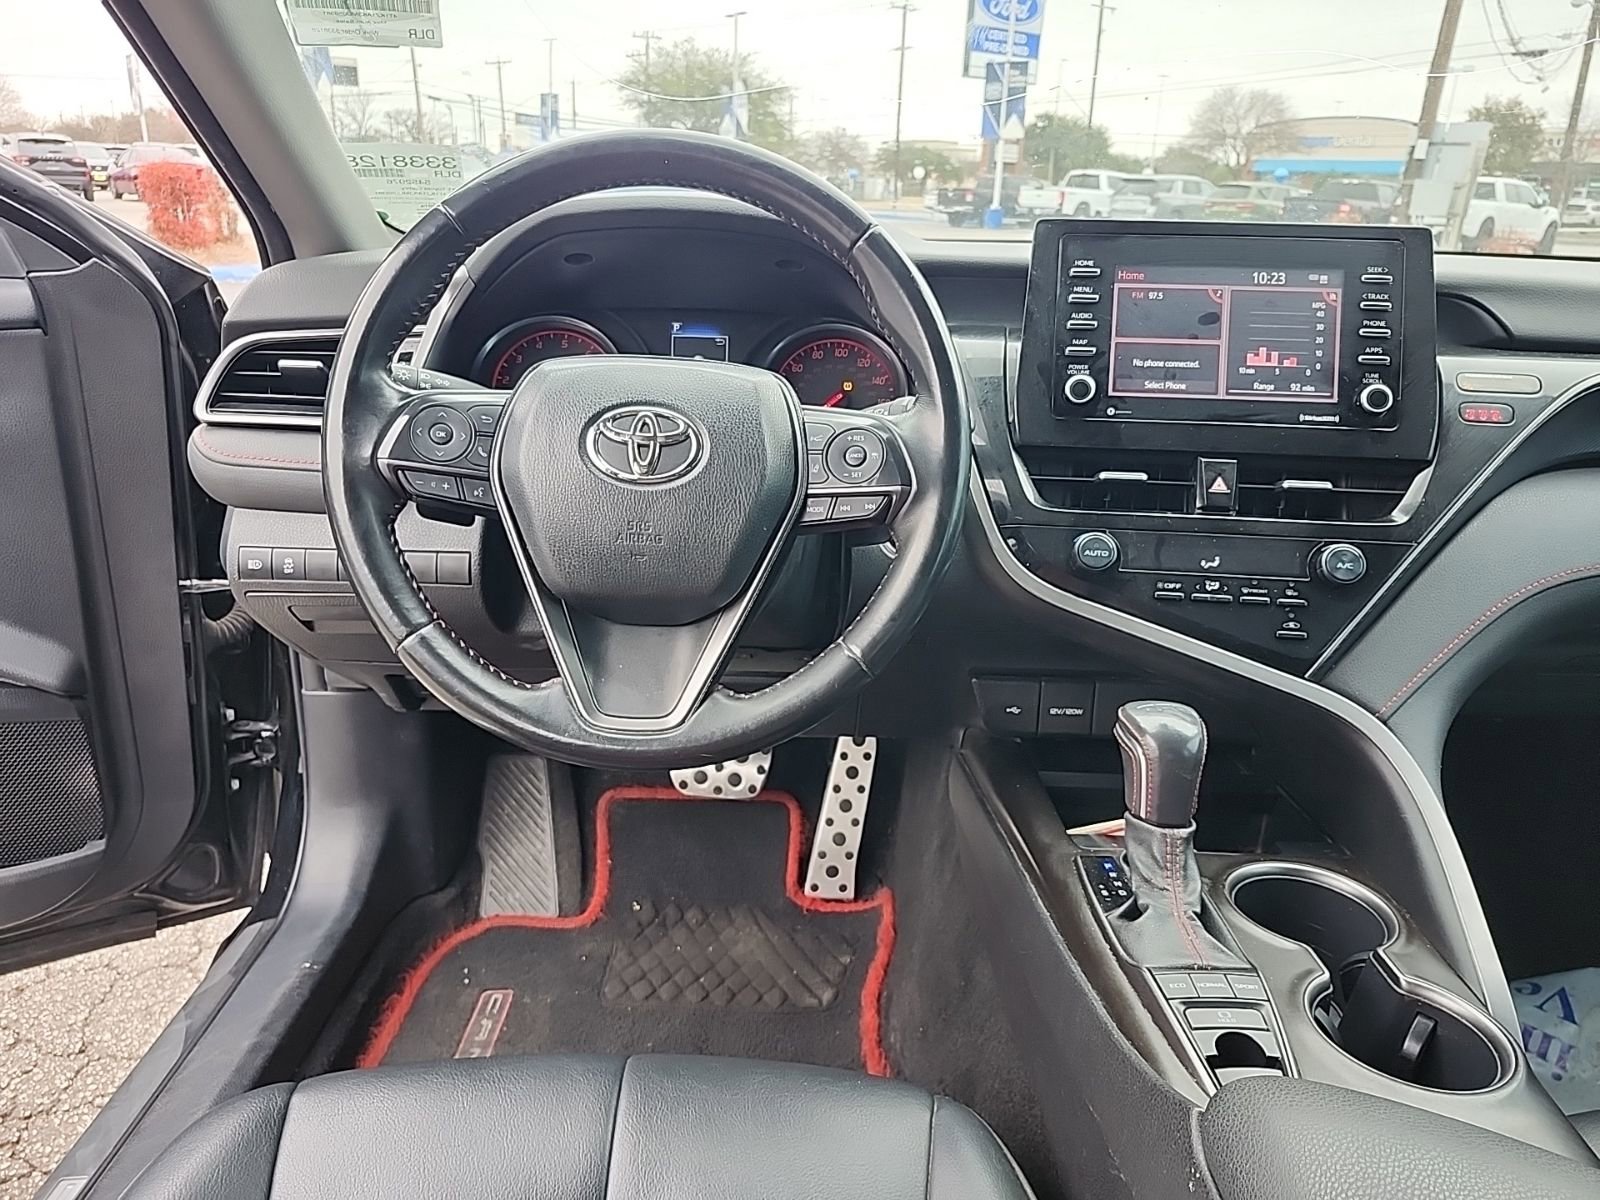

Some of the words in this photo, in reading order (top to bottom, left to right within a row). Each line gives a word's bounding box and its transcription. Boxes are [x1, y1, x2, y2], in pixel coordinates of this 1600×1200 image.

[989, 0, 1032, 19] Fod
[1118, 270, 1144, 280] Home
[1252, 272, 1286, 284] 10:23
[1131, 291, 1144, 299] FM
[1148, 291, 1164, 299] 97.5
[1315, 323, 1325, 331] 30
[561, 340, 568, 348] 5
[1315, 336, 1324, 344] 20
[812, 350, 823, 360] 80
[834, 348, 848, 357] 100
[1315, 349, 1324, 357] 10
[516, 355, 522, 364] 3
[857, 358, 871, 368] 120
[1132, 359, 1143, 367] No
[1144, 359, 1164, 368] phone
[1165, 360, 1200, 368] connected.
[791, 363, 803, 373] 60
[502, 376, 510, 384] 2
[872, 376, 886, 385] 140
[1144, 381, 1164, 389] Select
[1165, 382, 1186, 390] Phone
[1253, 382, 1275, 391] Range
[1290, 383, 1301, 391] 92
[614, 533, 665, 546] AIRBAG
